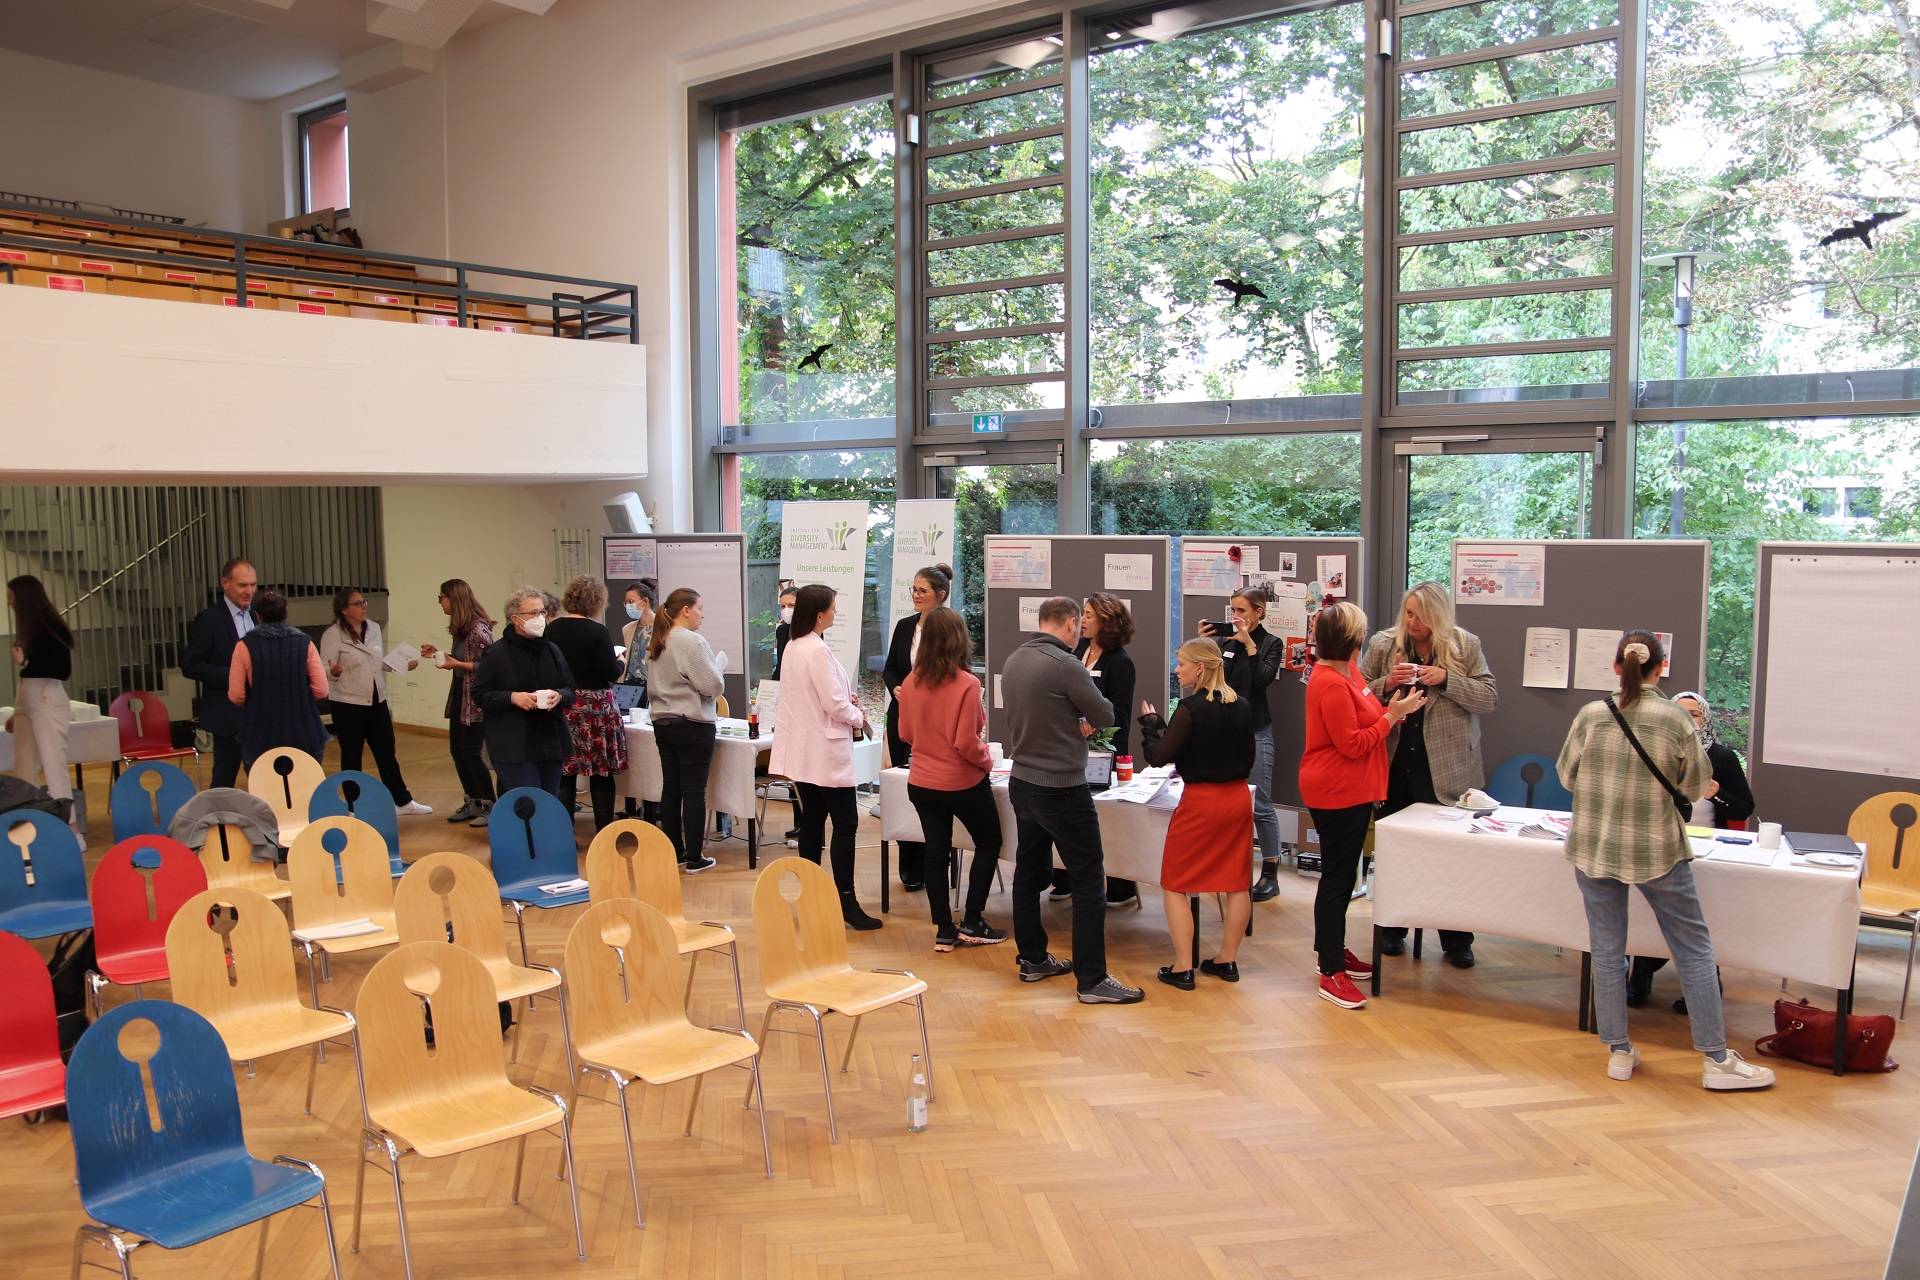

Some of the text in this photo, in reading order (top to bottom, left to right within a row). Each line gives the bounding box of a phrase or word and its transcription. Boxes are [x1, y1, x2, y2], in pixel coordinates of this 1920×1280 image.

[790, 534, 819, 542] DIVERSITY
[790, 543, 829, 551] MANAGEMENT
[797, 563, 855, 575] Unsere Leistungen
[1108, 563, 1131, 571] Frauen
[1022, 606, 1040, 614] Fraue
[1266, 614, 1297, 626] Soziale
